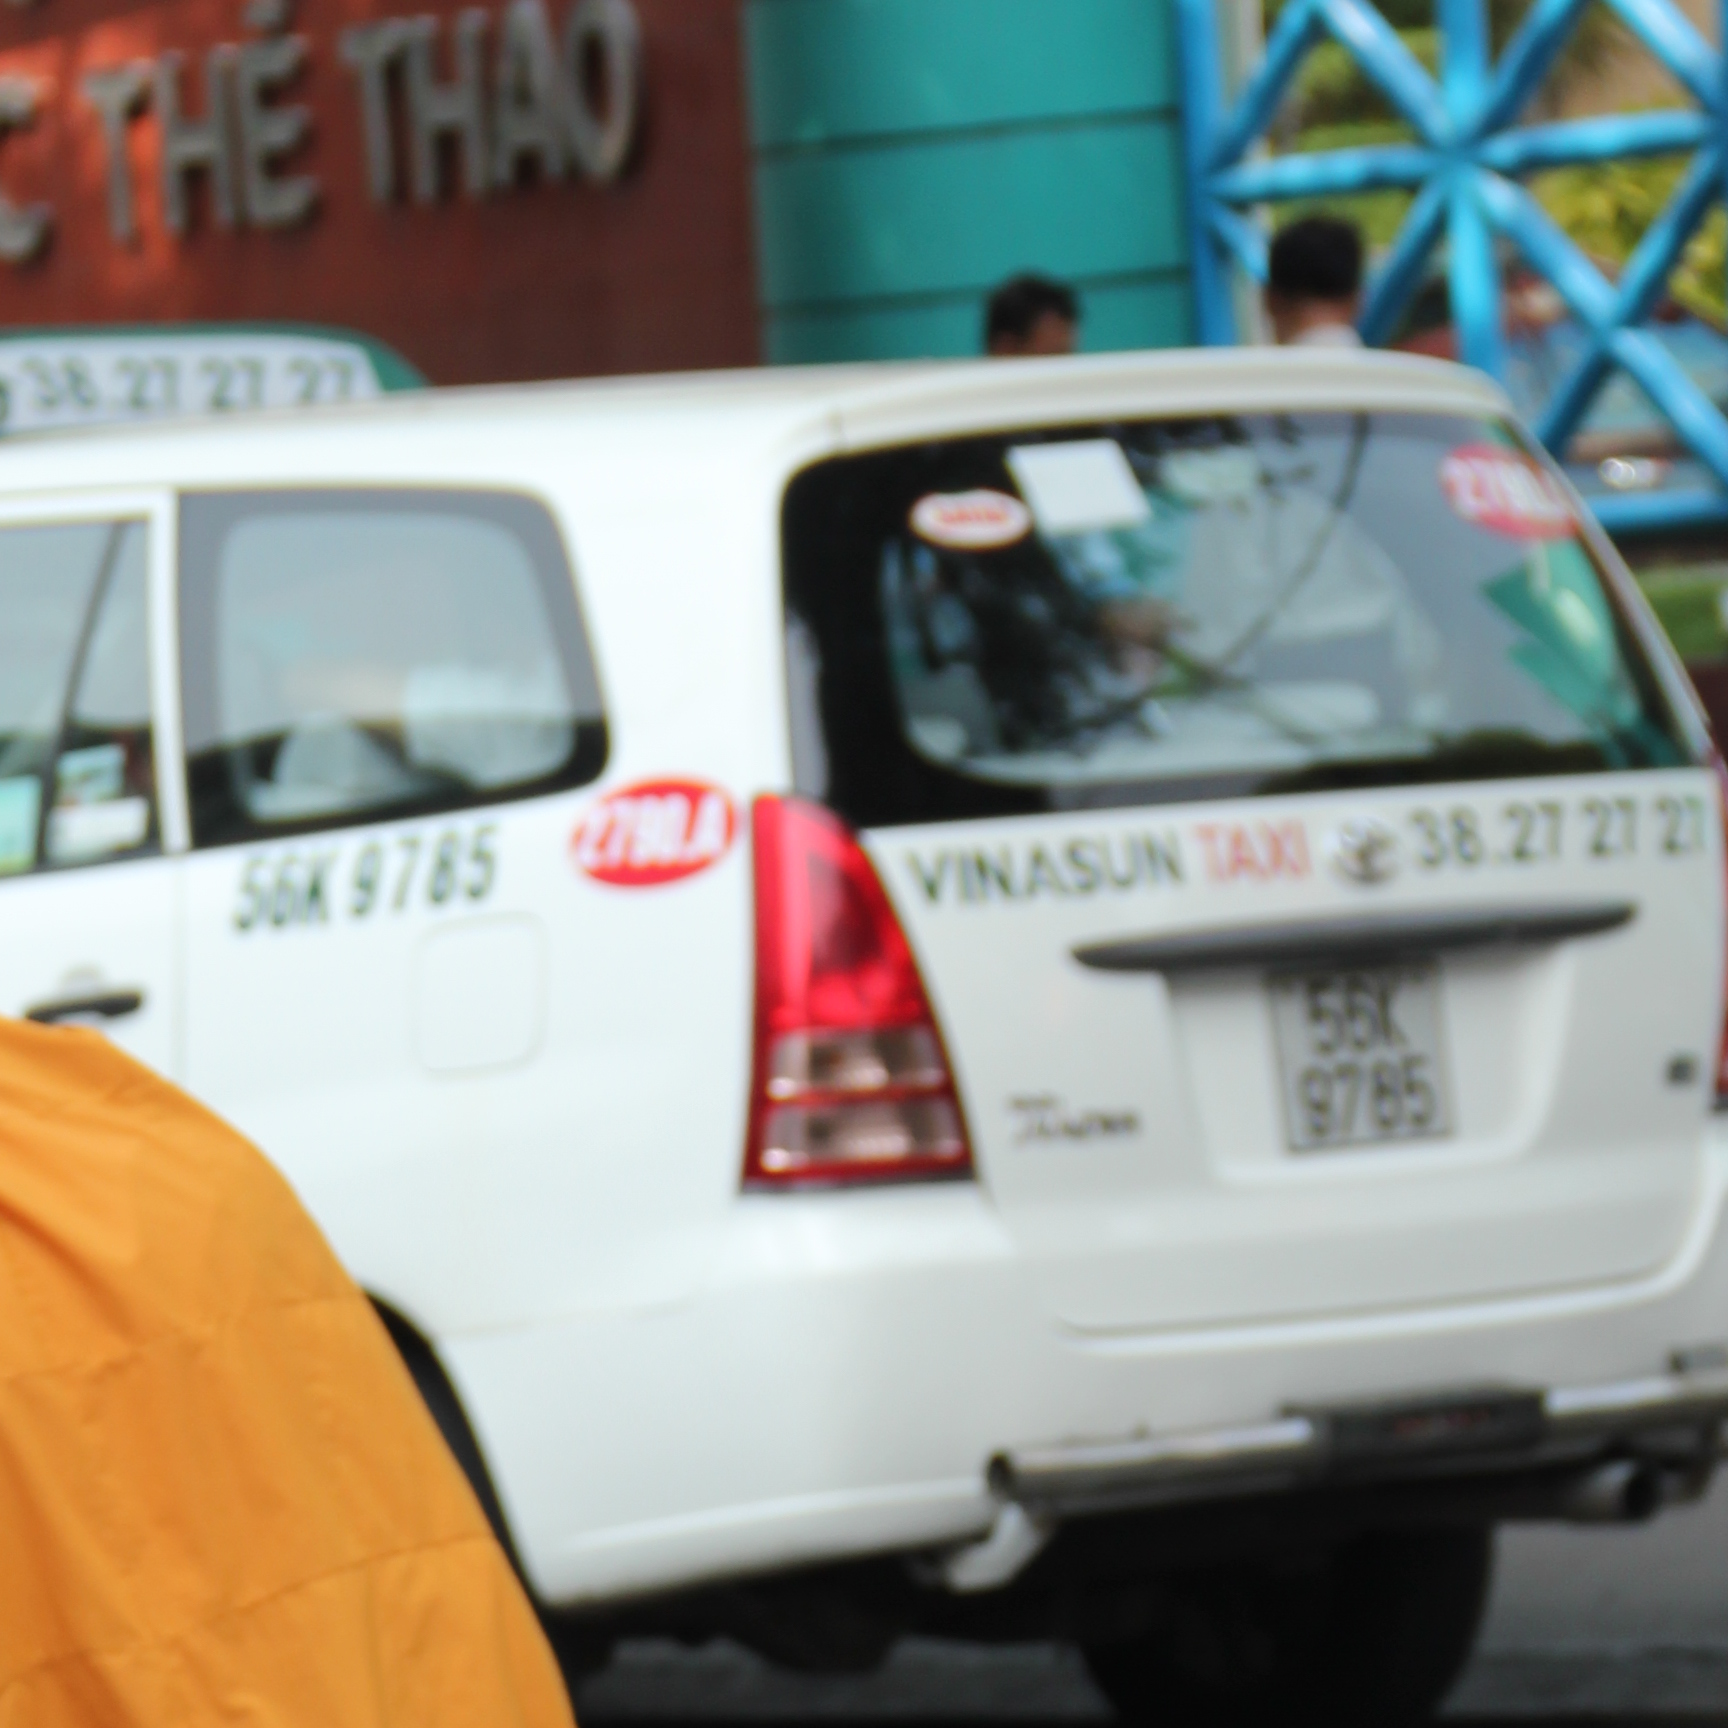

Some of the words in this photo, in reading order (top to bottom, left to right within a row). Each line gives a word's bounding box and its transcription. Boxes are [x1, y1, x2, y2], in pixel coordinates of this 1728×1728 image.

[232, 849, 340, 931] 56K
[351, 822, 498, 917] 9785
[907, 825, 1184, 903] VINASUN
[1193, 818, 1313, 883] TAXI
[1582, 797, 1638, 858] 27
[1655, 796, 1709, 857] 27
